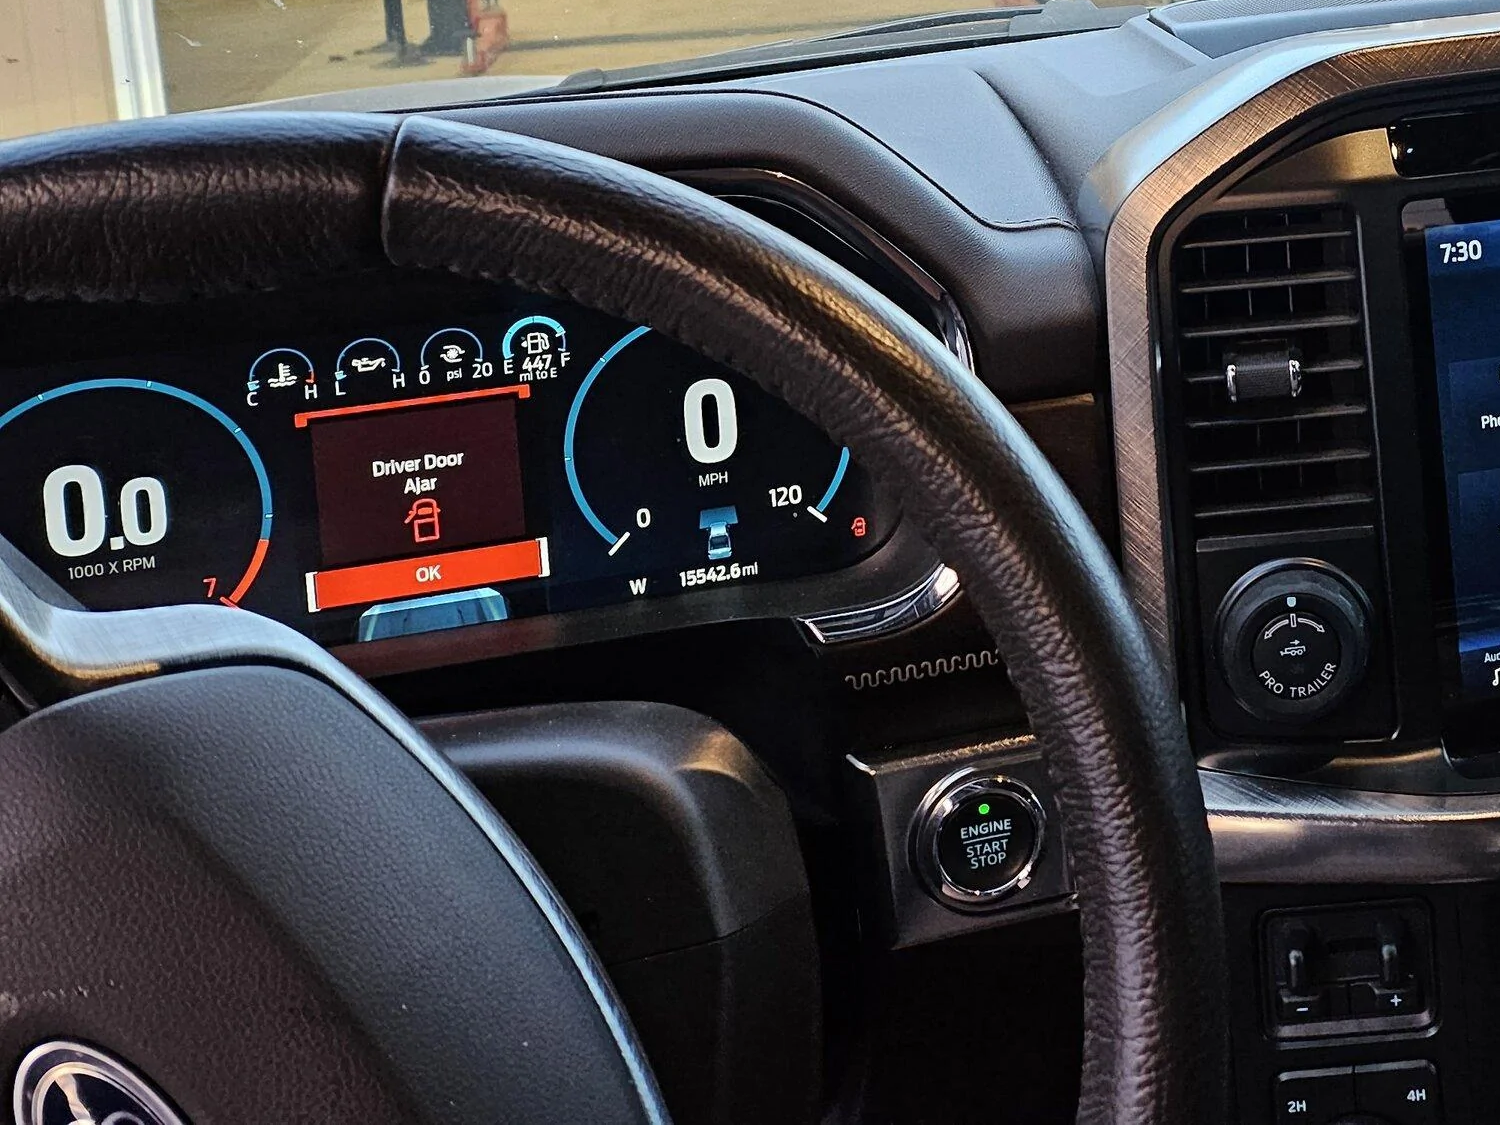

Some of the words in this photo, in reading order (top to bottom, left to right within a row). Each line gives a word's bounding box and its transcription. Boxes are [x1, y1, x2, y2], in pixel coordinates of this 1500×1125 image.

[1439, 239, 1483, 264] 7:30
[503, 359, 514, 374] E
[522, 354, 552, 372] 447
[560, 352, 571, 367] F
[391, 373, 406, 389] H
[418, 370, 431, 386] 0
[446, 367, 463, 382] psi
[471, 362, 493, 379] 20
[519, 371, 533, 382] mi
[535, 369, 548, 380] to
[550, 367, 558, 378] E
[303, 384, 318, 400] H
[335, 381, 347, 397] L
[246, 391, 260, 408] C
[684, 378, 738, 464] 0
[372, 456, 421, 478] Driver
[423, 451, 464, 471] Door
[404, 477, 437, 496] Ajar
[698, 471, 729, 487] MPH
[768, 484, 803, 508] 120
[43, 464, 168, 558] 0.0
[635, 507, 651, 529] 0
[68, 564, 104, 580] 1000
[108, 561, 119, 574] X
[122, 556, 156, 572] RPM
[415, 564, 442, 583] OK
[202, 578, 217, 598] 7
[629, 579, 648, 596] W
[1259, 670, 1285, 695] PRO
[1289, 661, 1337, 698] TRAILER
[960, 818, 1012, 840] ENGINE
[966, 838, 1009, 858] START
[970, 851, 1007, 870] STOP
[1406, 1088, 1426, 1102] 4H
[1287, 1100, 1307, 1114] 2H
